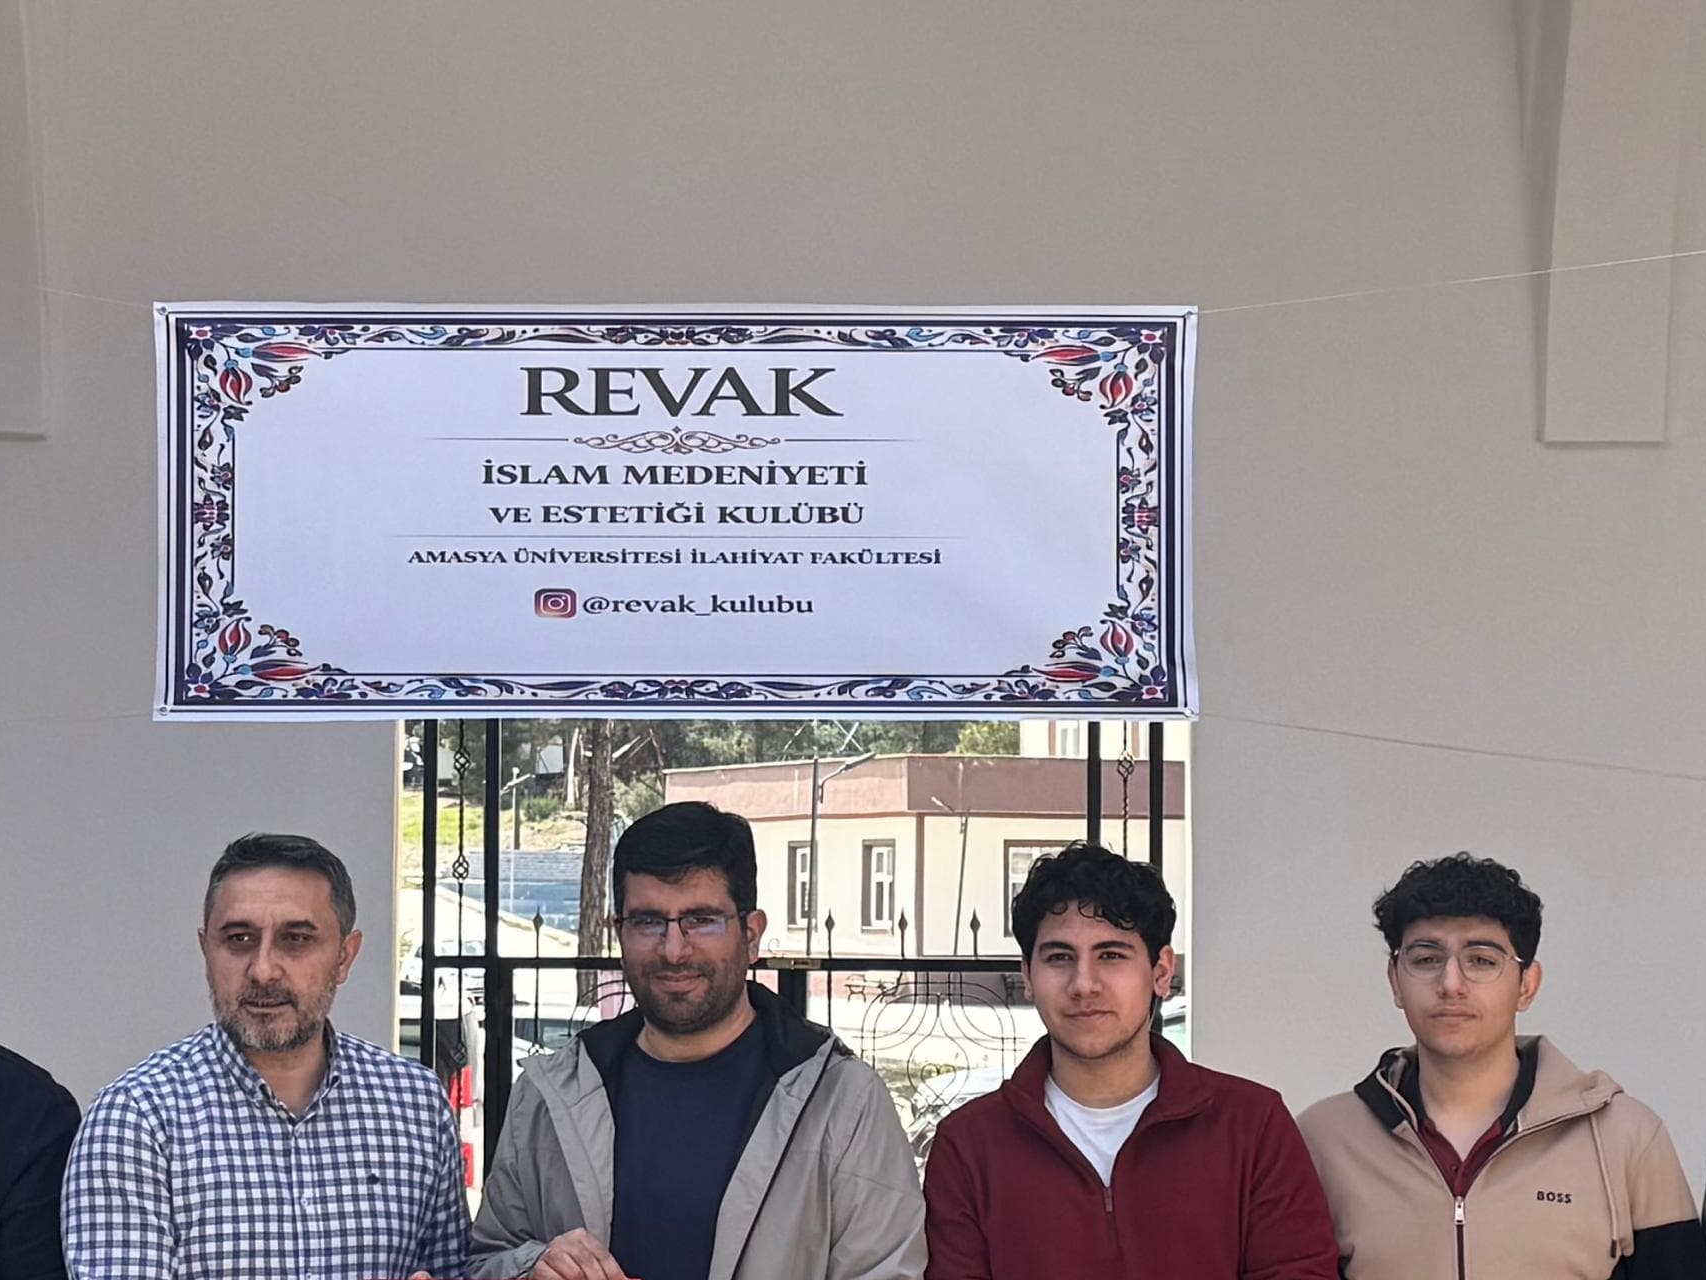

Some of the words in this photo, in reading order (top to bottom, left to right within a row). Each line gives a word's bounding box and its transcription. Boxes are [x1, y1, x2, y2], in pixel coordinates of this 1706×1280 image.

[519, 366, 844, 417] REVAK
[482, 459, 609, 486] İSLAM
[622, 459, 869, 486] MEDENİYETİ
[489, 506, 532, 524] VE
[541, 501, 706, 525] ESTETİĞİ
[717, 502, 865, 525] KULÜBÜ
[408, 550, 507, 564] AMASYA
[514, 548, 682, 564] ÜNİVERSİTESİ
[691, 548, 804, 565] İLAHİYAT
[810, 548, 942, 565] FAKÜLTESİ
[582, 594, 814, 616] @revak_kulubu
[1537, 1190, 1572, 1204] BOSS
